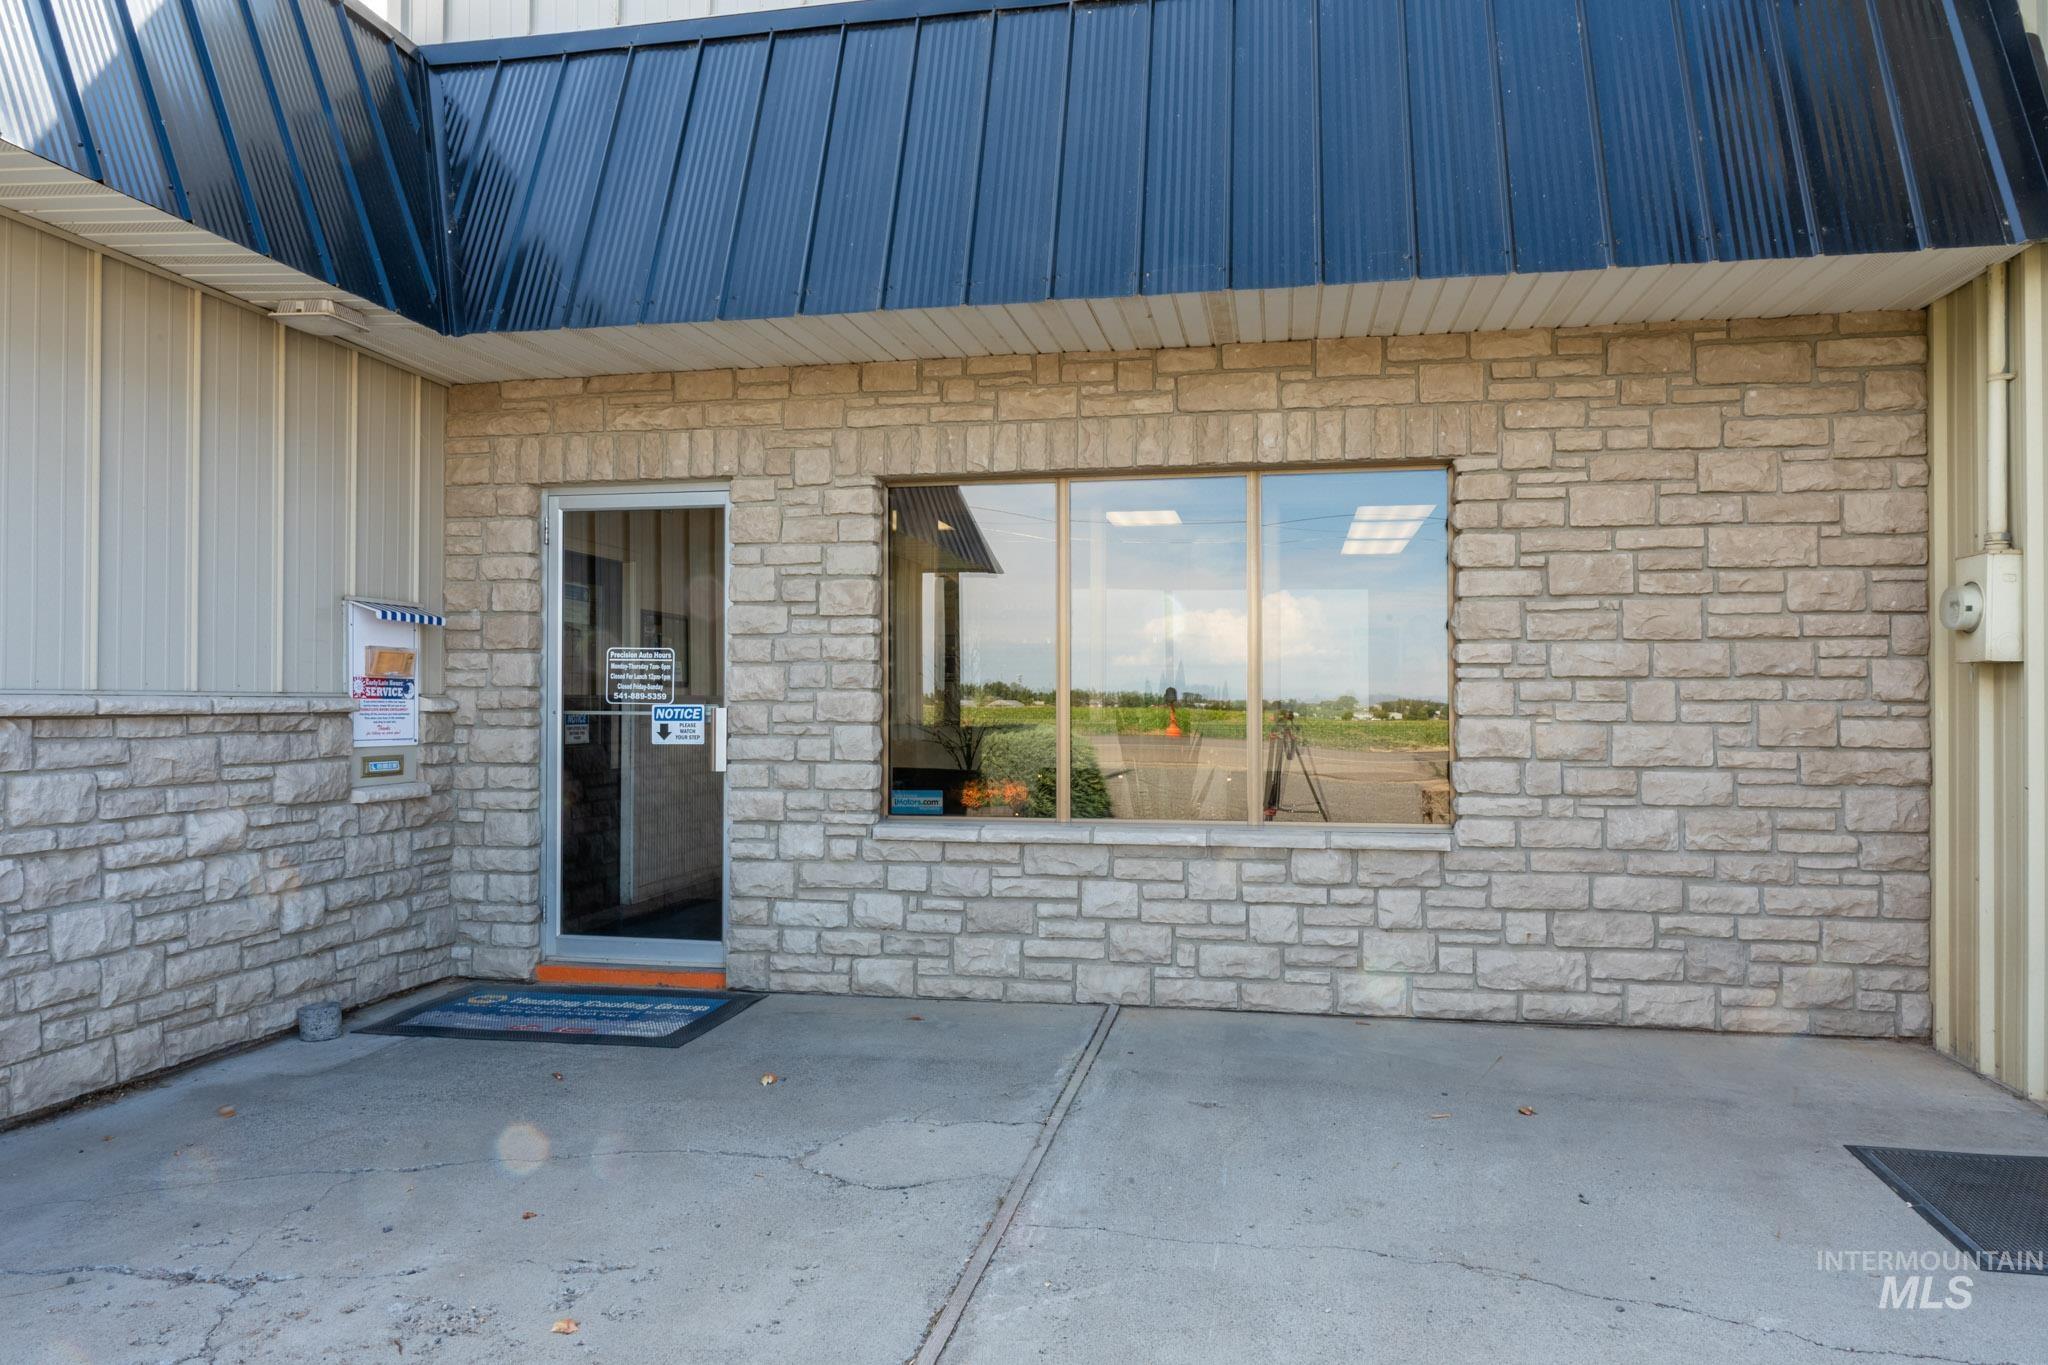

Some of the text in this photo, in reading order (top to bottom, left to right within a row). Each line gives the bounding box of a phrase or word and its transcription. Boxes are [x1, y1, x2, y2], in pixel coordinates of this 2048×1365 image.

[653, 651, 672, 659] Hours
[365, 687, 404, 697] SERVICE
[655, 708, 702, 720] NOTICE
